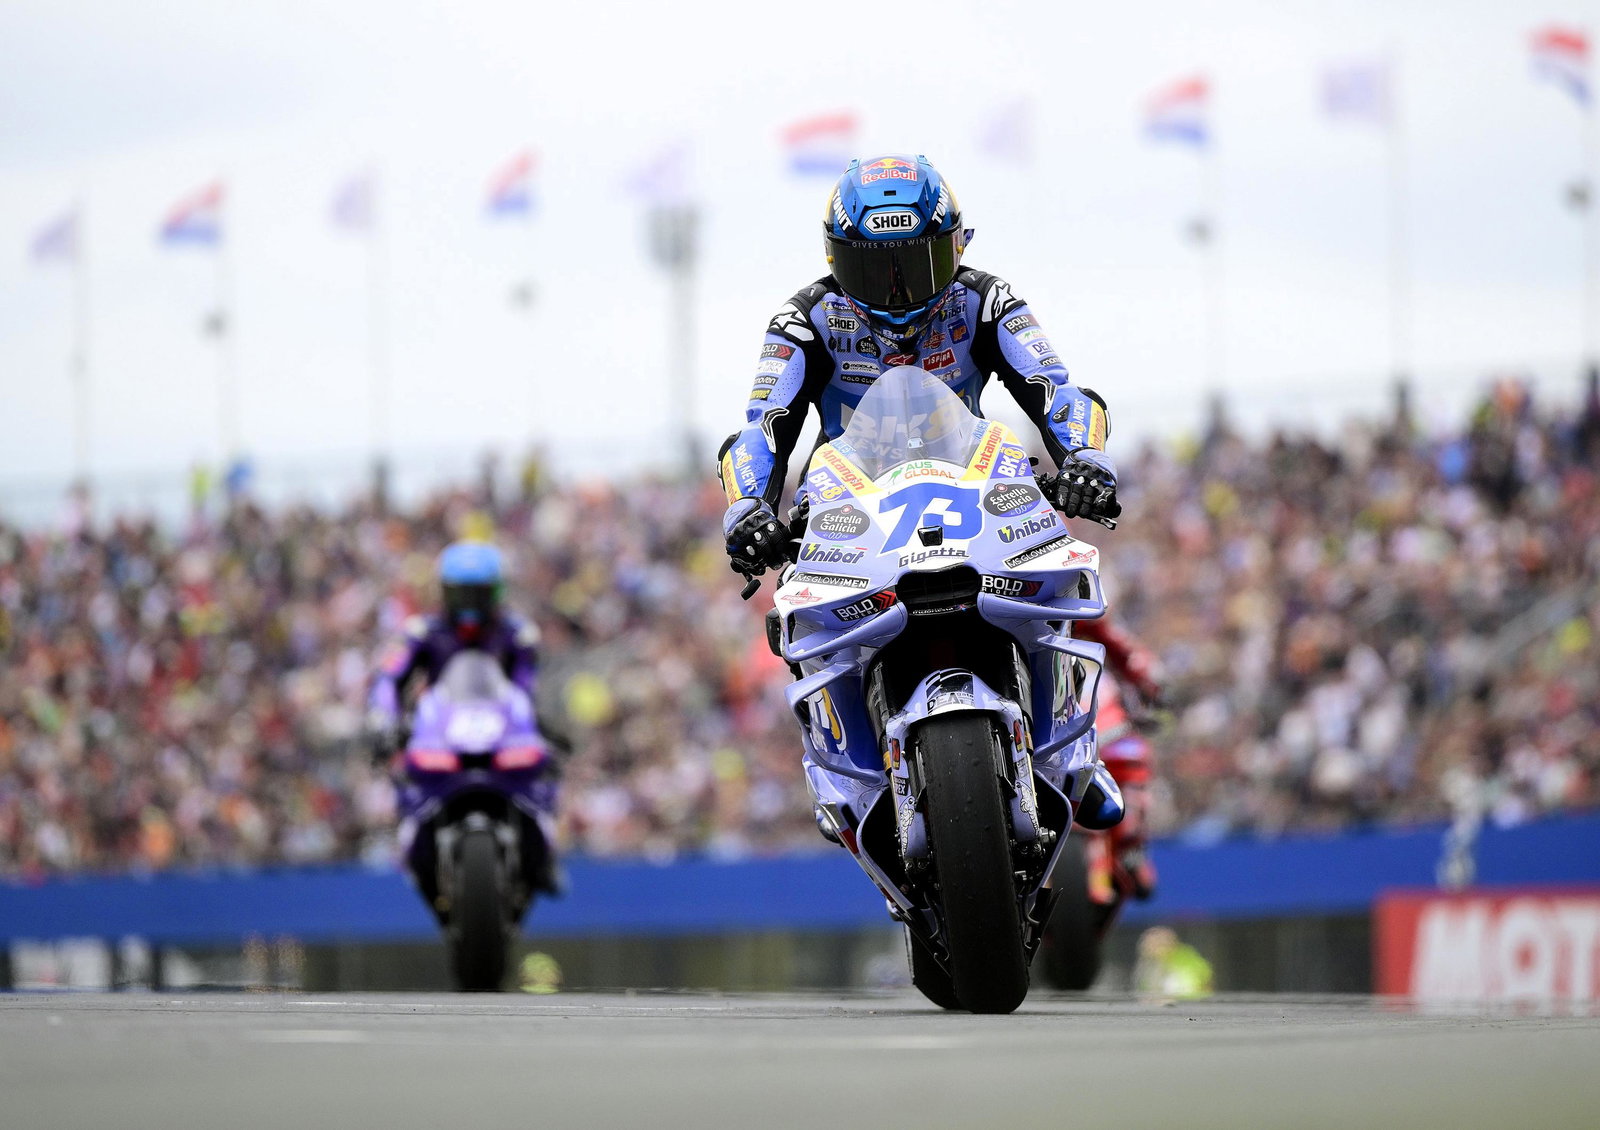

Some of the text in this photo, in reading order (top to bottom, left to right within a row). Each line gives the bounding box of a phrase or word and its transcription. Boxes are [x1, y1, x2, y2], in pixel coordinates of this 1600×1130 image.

[861, 169, 918, 185] Red Bull
[872, 215, 912, 229] SHOEI
[851, 241, 878, 249] GIVES
[907, 235, 937, 246] WINGS
[828, 318, 855, 330] SHOEI
[1005, 315, 1029, 330] BOLD
[1067, 399, 1086, 447] BK8 NEWS
[974, 425, 1003, 475] Antangin
[735, 443, 758, 493] BK8 NEWS
[821, 448, 865, 491] Antangin
[905, 461, 933, 471] AUS
[997, 446, 1027, 478] BK8
[904, 469, 956, 480] GLOBAL
[808, 471, 846, 502] BK8
[989, 488, 1029, 505] Estrella
[996, 495, 1033, 512] Galicia
[821, 513, 863, 525] Estrella
[878, 482, 985, 555] 73
[820, 522, 857, 533] Galicia
[997, 512, 1058, 544] Unibat
[800, 543, 864, 564] Unibat
[898, 547, 969, 568] Gigetta
[981, 587, 1020, 596] RIDERS
[982, 575, 1023, 592] BOLD
[837, 599, 874, 618] BOLD
[844, 607, 879, 621] RIDERS
